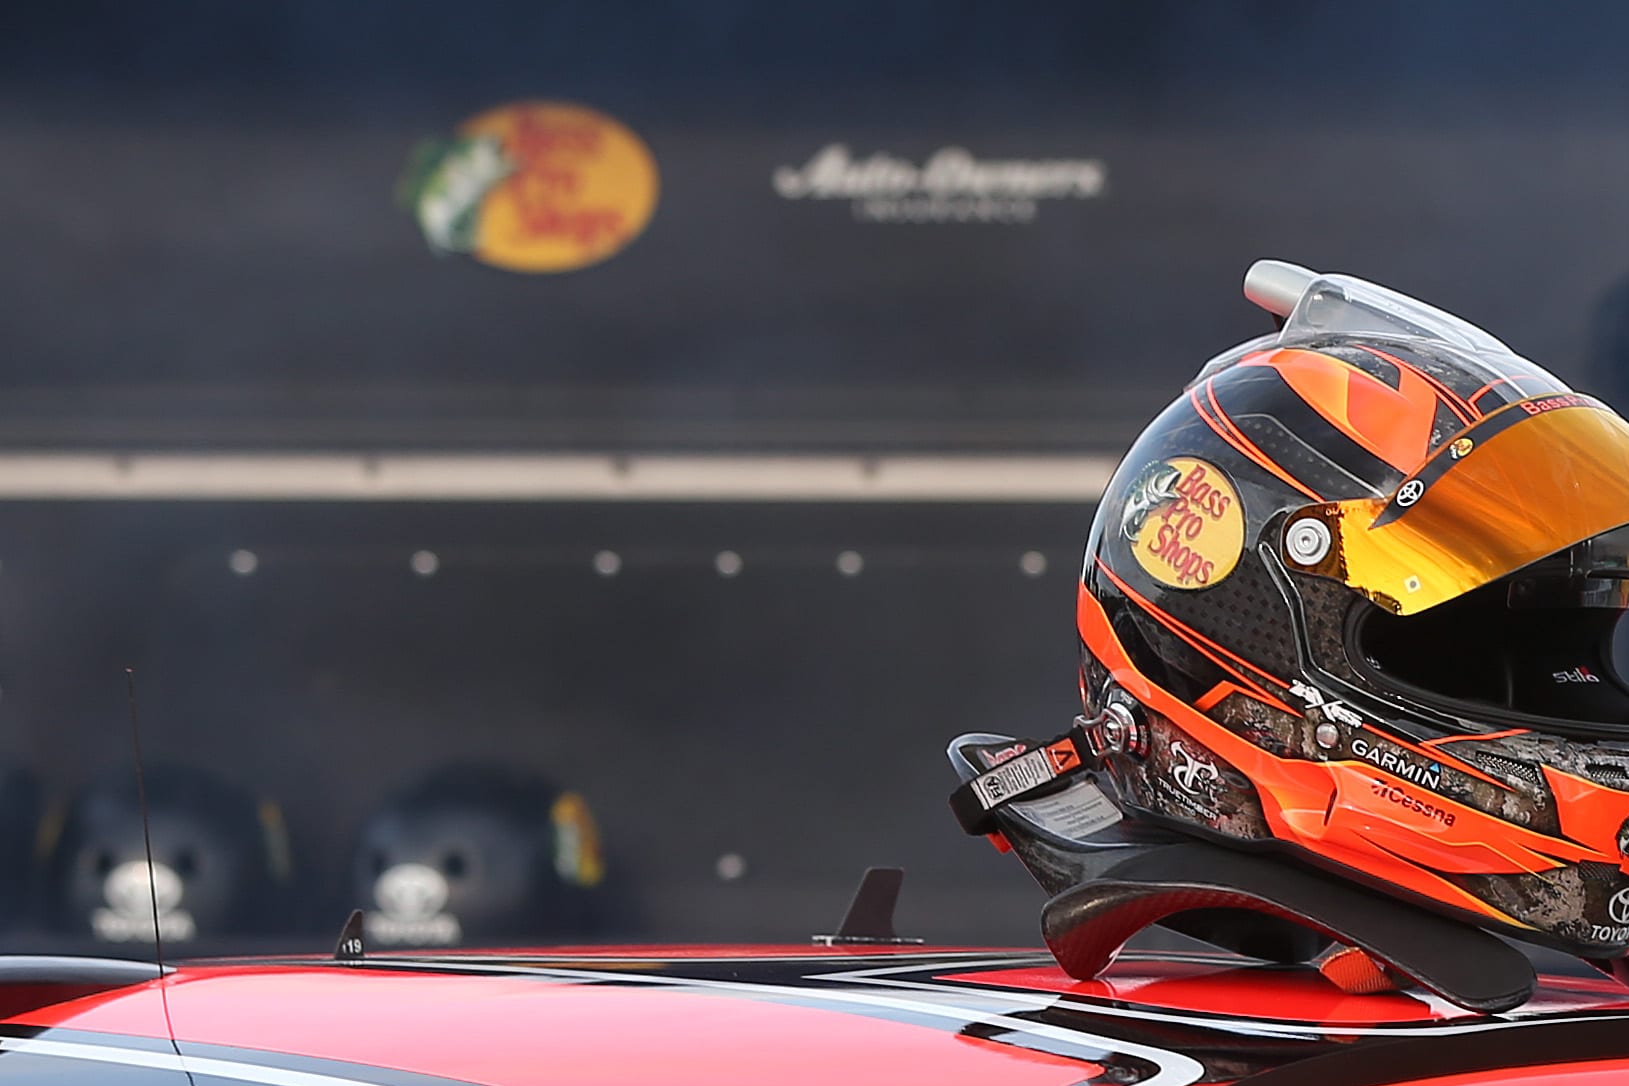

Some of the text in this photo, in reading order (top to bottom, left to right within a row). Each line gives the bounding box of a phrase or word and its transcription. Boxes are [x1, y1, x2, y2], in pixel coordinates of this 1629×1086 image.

[1175, 463, 1231, 518] Bass
[1161, 496, 1204, 541] Pro
[1148, 522, 1215, 586] Shops
[1351, 738, 1441, 790] GARMIN
[1388, 786, 1457, 827] Cessna
